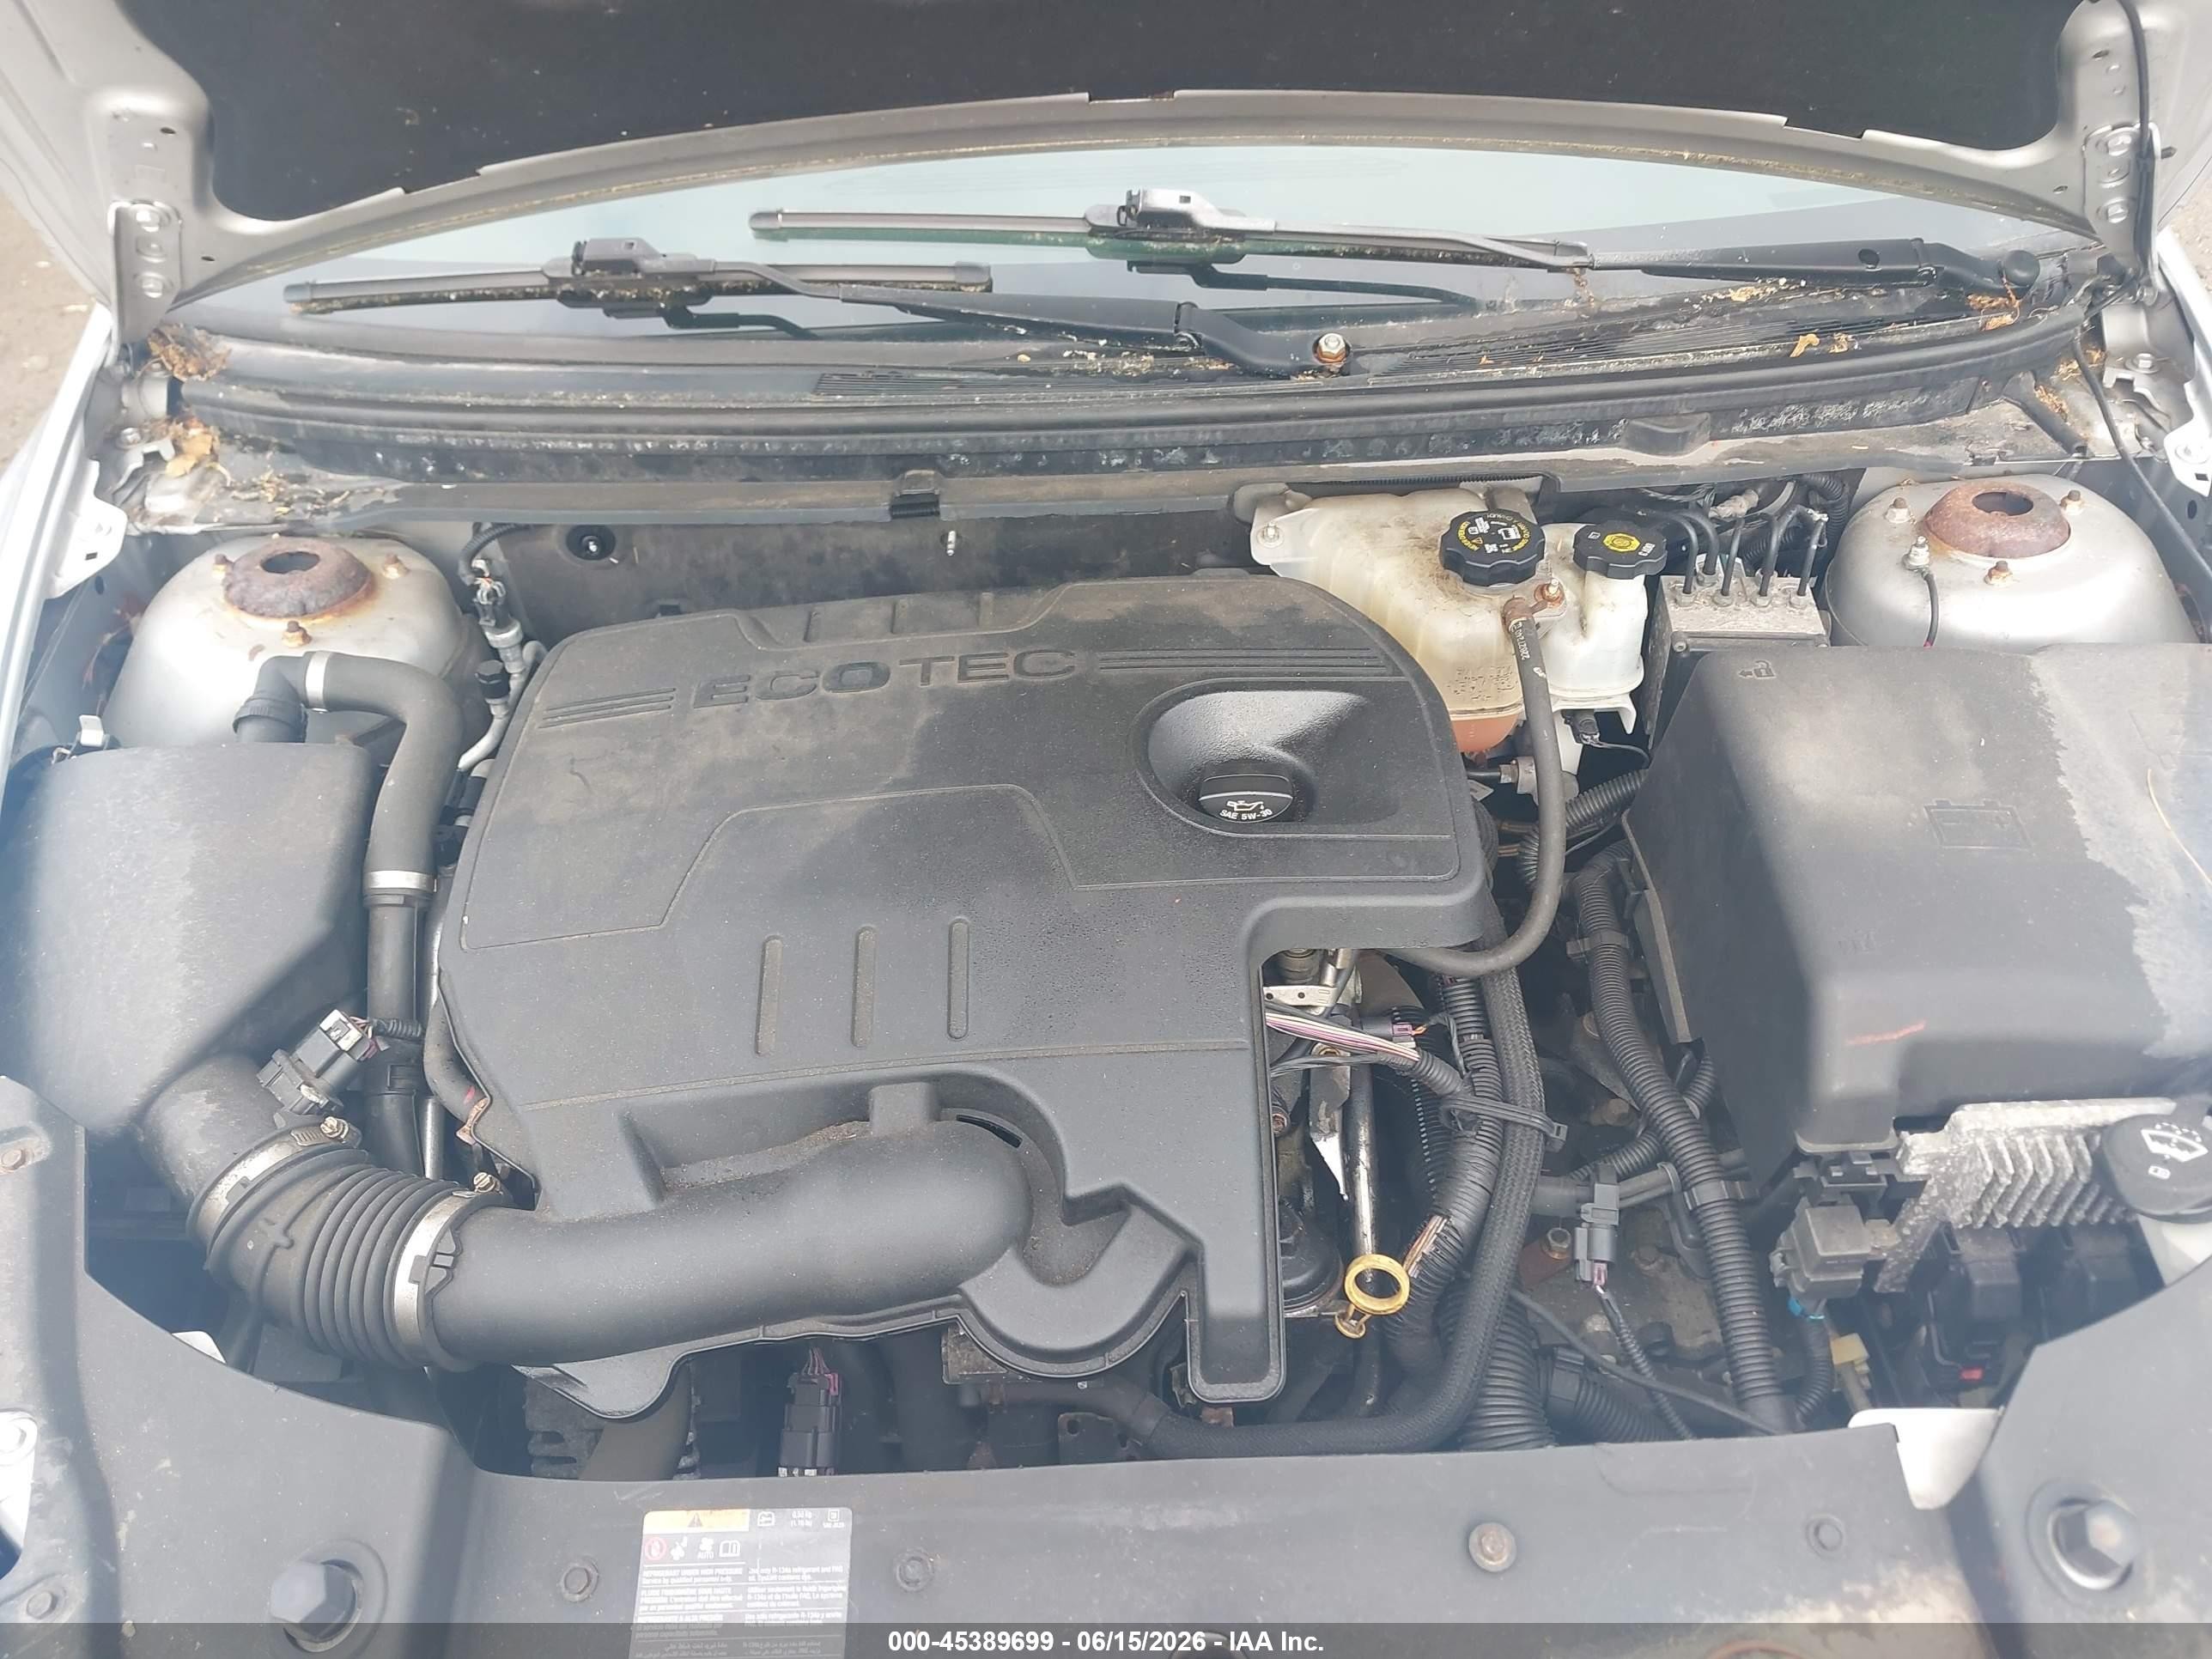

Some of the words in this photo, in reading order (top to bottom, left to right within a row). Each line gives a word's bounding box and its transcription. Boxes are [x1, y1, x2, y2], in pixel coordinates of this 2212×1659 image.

[692, 648, 1077, 710] ECOTEC
[1219, 809, 1238, 820] SAE
[1241, 808, 1273, 820] 5W-30
[697, 1551, 714, 1560] AUTO
